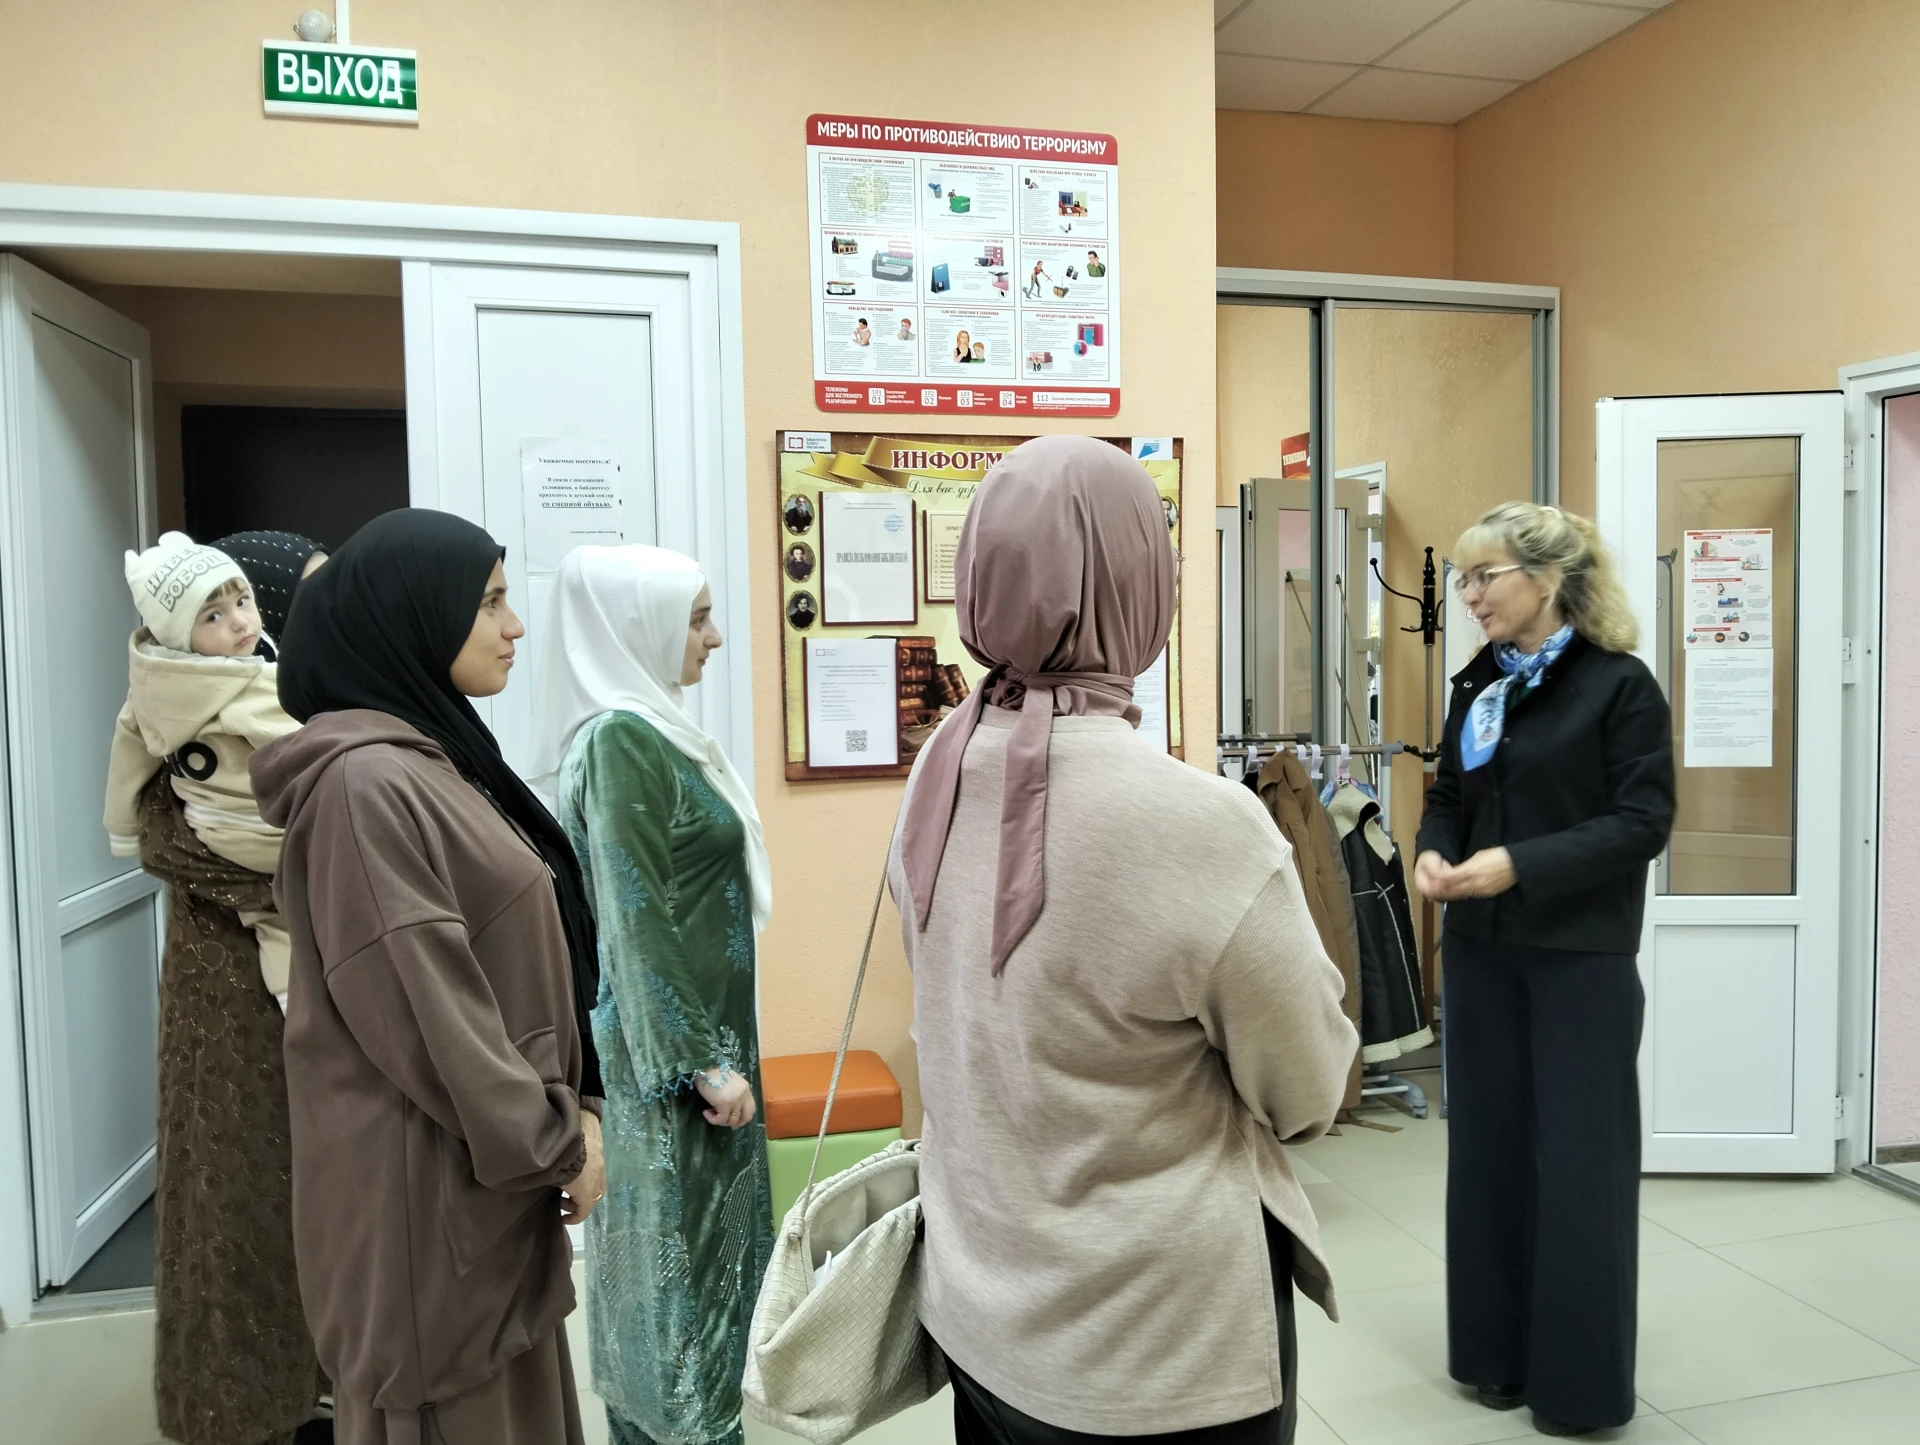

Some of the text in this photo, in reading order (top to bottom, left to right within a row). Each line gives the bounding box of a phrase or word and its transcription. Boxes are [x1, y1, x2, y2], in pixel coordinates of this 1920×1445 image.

[277, 52, 404, 105] ВЫХОД
[817, 120, 1108, 156] МЕРЫ ПО ПРОТИВОДЕЙСТВИЮ ТЕРРОРИЗМУ
[908, 480, 933, 494] Для
